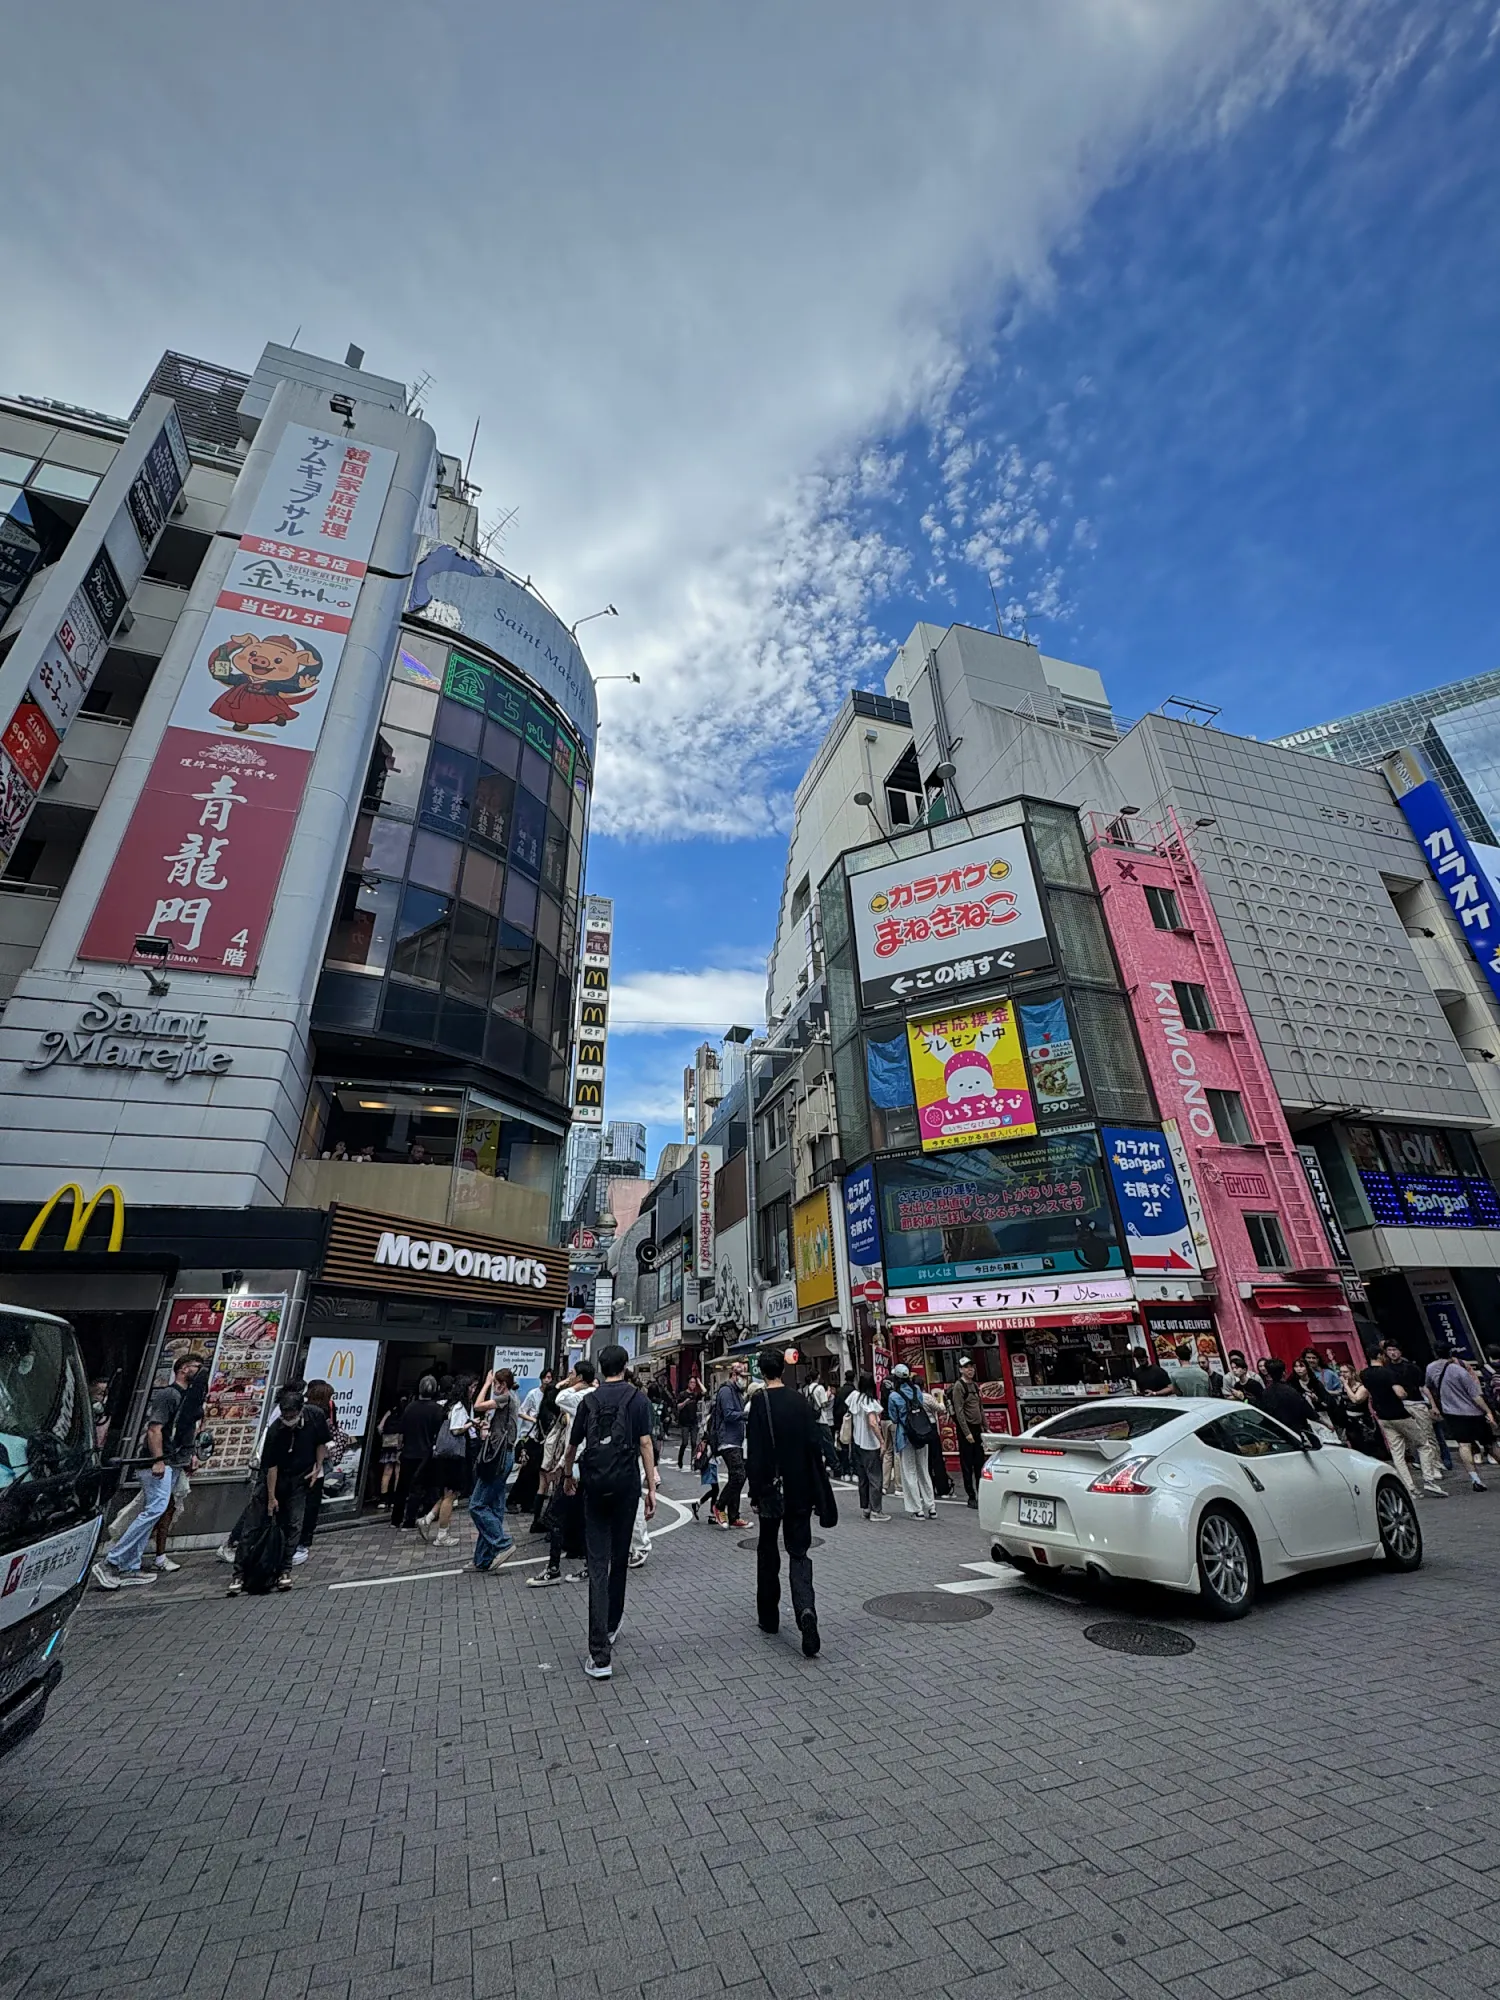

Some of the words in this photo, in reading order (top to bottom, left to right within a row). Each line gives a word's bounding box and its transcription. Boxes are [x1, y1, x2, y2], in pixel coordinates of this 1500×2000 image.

[274, 436, 334, 537] サムギョプサル
[319, 446, 372, 540] 韓国家庭料理
[257, 541, 350, 572] 渋谷2号店
[240, 599, 298, 620] 当ビル
[302, 614, 325, 625] 5F
[494, 608, 541, 648] Saint
[26, 713, 47, 745] ZINO
[1282, 723, 1342, 749] HULIC
[147, 775, 248, 950] 青龍門
[889, 862, 988, 909] カラオケ
[1424, 827, 1490, 930] カラオケ
[875, 892, 1019, 957] まねきねこ
[916, 950, 1016, 990] この横すぐ
[79, 990, 208, 1040] Saint
[914, 1007, 1009, 1040] 入店応援金
[921, 1027, 1006, 1054] プレゼント中
[23, 1031, 234, 1080] Marejie
[1150, 982, 1215, 1137] KIMONO
[945, 1094, 1023, 1119] いちごなび
[1042, 1101, 1069, 1114] 590
[1056, 1145, 1077, 1154] JAPAN
[1115, 1140, 1160, 1156] カラオケ
[1305, 1157, 1315, 1165] 2F
[1120, 1157, 1165, 1173] BanBan
[700, 1161, 710, 1199] カラオケ
[848, 1179, 870, 1199] カラオケ
[898, 1181, 977, 1202] さそり座の運勢
[1123, 1181, 1171, 1199] 右隣すぐ
[1173, 1146, 1200, 1222] マモケバブ
[1227, 1175, 1267, 1194] GYUTTO
[1309, 1169, 1331, 1214] カラオケ
[849, 1192, 872, 1214] BanBan
[899, 1181, 1082, 1216] 支出を見直すヒントがありそう
[1142, 1202, 1163, 1217] 2F
[1415, 1193, 1469, 1212] BanBan
[700, 1211, 712, 1271] まねきねこ
[374, 1231, 547, 1289] McDonald's
[918, 1266, 952, 1279] 詳しくは
[949, 1285, 1062, 1309] マモケバブ
[914, 1326, 944, 1334] HALAL
[976, 1320, 1003, 1330] MAMO
[1006, 1317, 1036, 1329] KEBAB
[1149, 1320, 1166, 1330] TAKE
[1166, 1320, 1178, 1329] OUT
[1184, 1320, 1211, 1329] DELIVERY
[1438, 1313, 1456, 1345] カラオケ
[936, 1333, 959, 1345] WAGYU
[1027, 1508, 1053, 1524] 42-02
